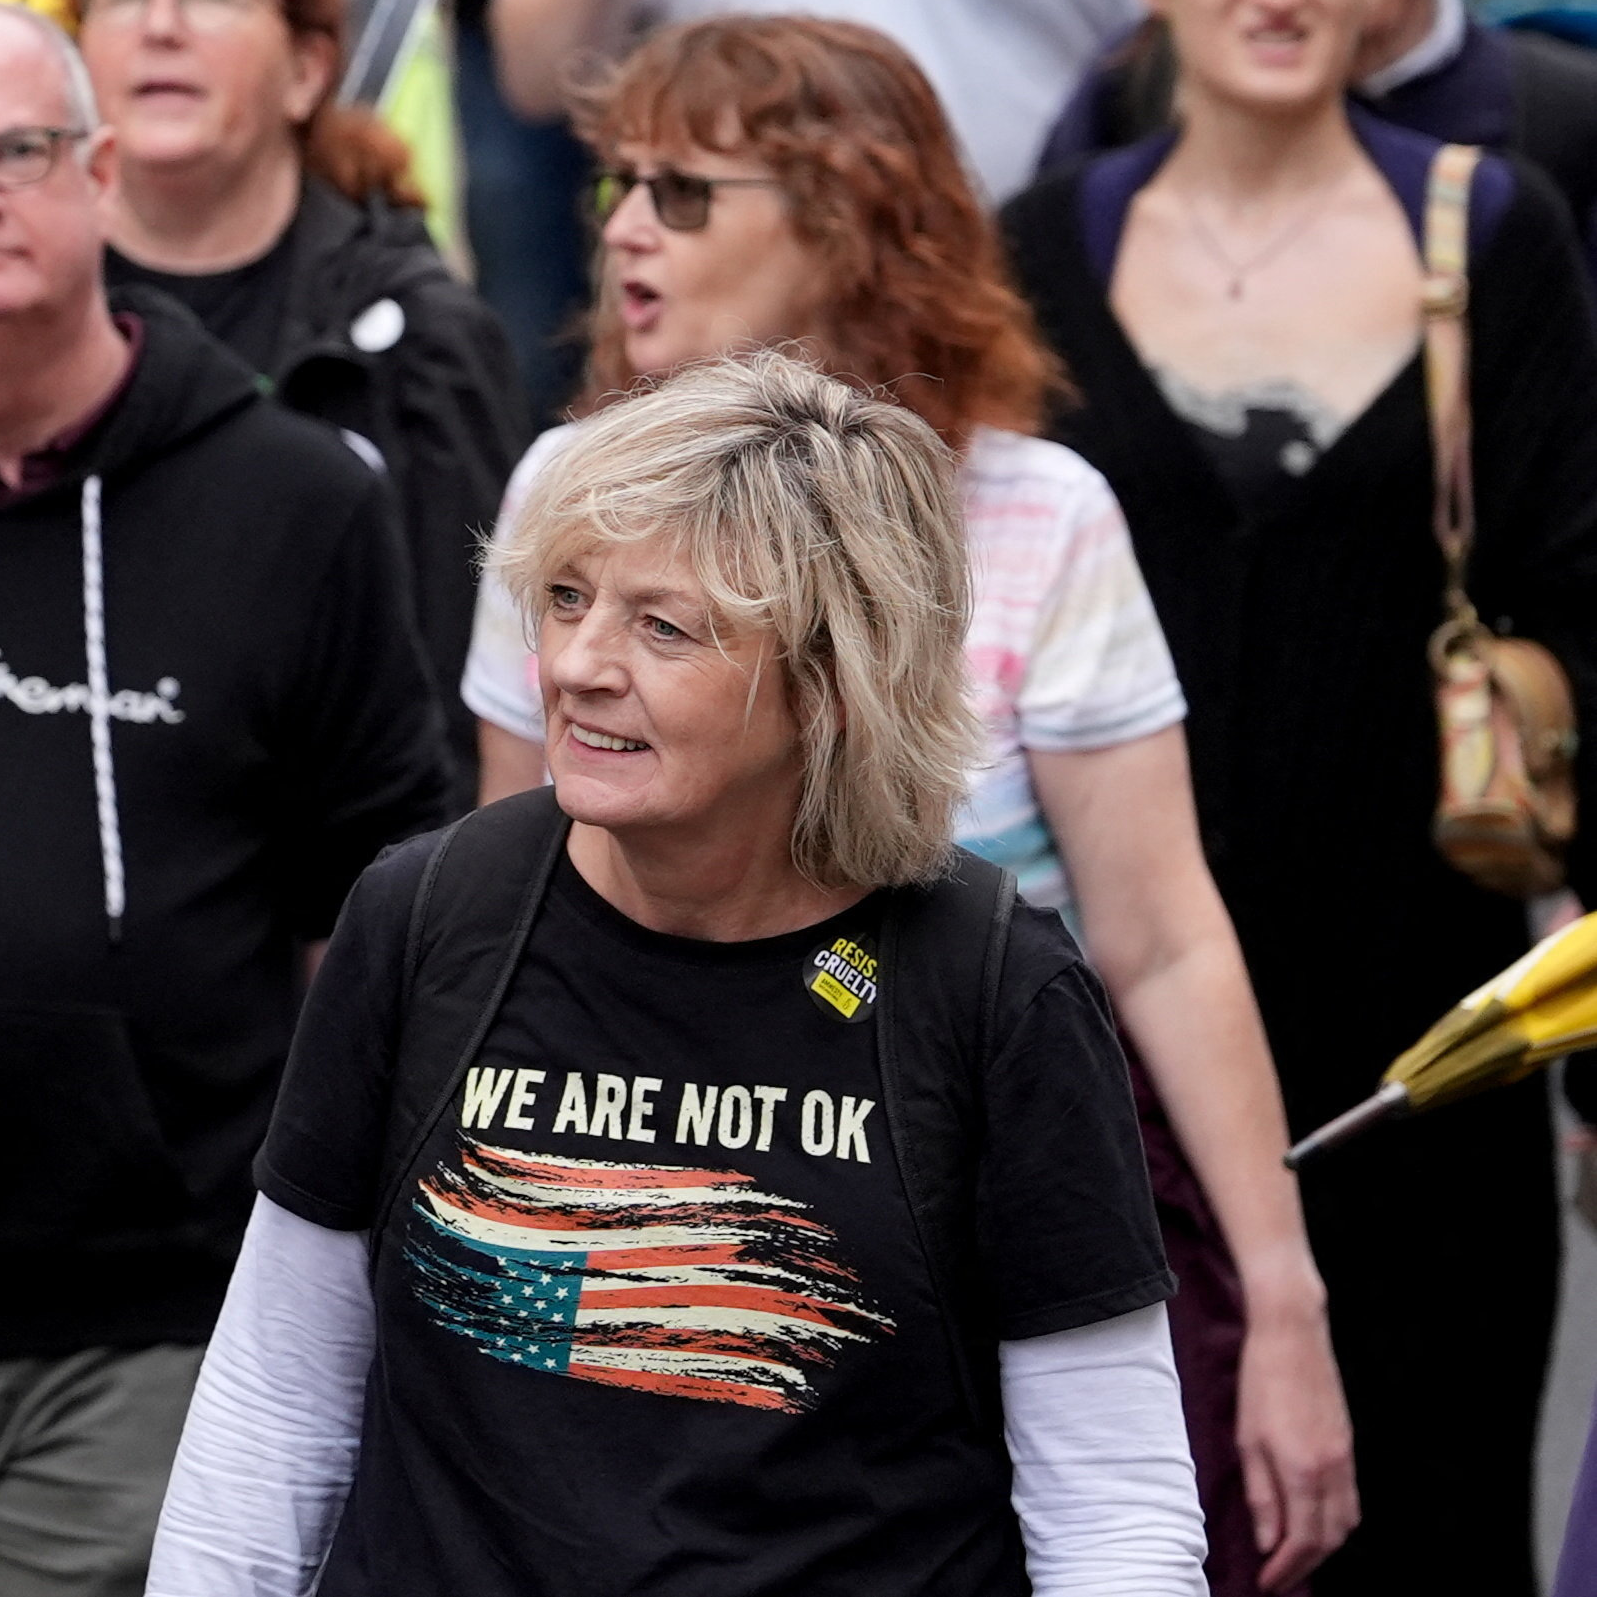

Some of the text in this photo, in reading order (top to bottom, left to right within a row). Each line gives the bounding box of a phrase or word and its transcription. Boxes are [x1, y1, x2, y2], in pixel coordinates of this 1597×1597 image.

[813, 950, 878, 1004] CRUELTY
[830, 938, 878, 982] RESIS
[461, 1067, 876, 1164] WE ARE NOT OK
